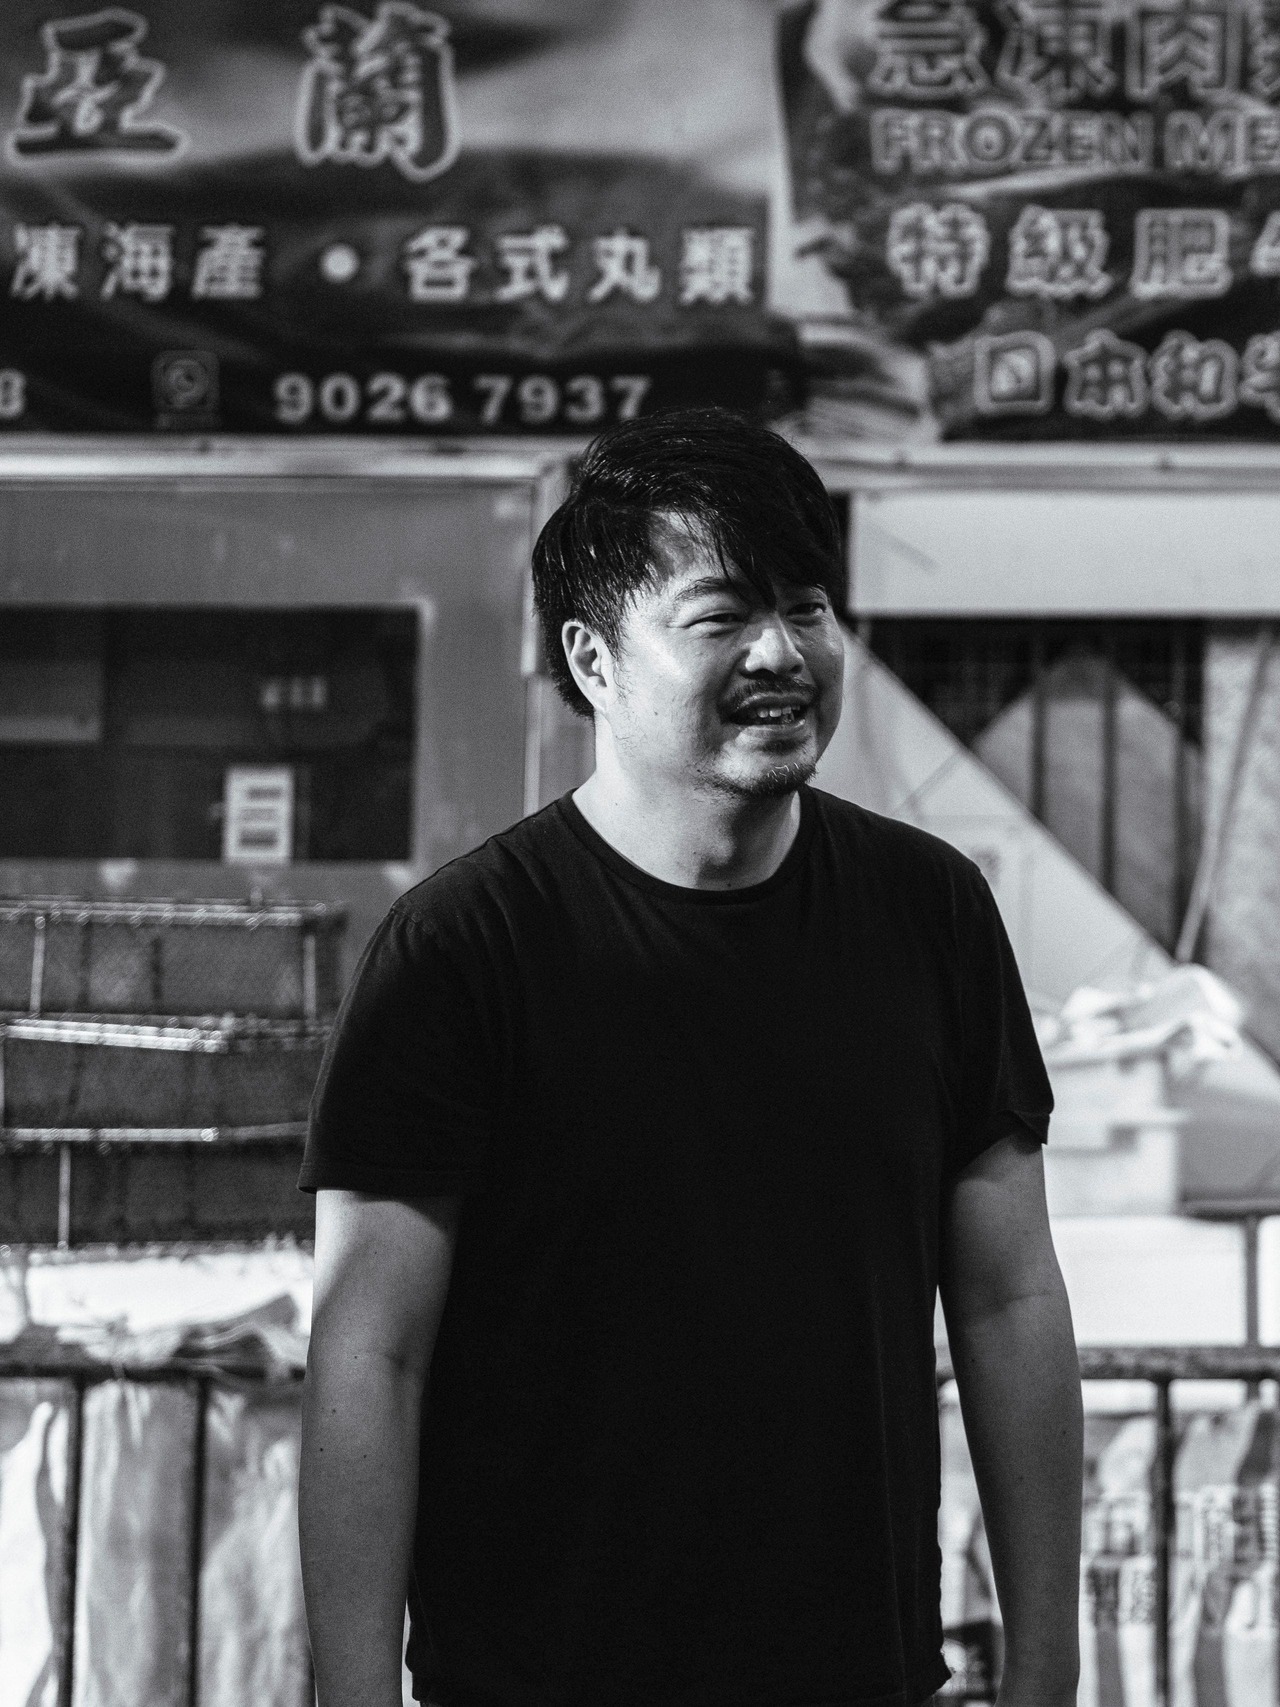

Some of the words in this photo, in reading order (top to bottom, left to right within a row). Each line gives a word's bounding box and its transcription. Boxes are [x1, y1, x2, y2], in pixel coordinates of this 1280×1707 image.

[870, 107, 1154, 174] FROZEN
[273, 371, 453, 423] 9026
[472, 372, 652, 423] 7937
